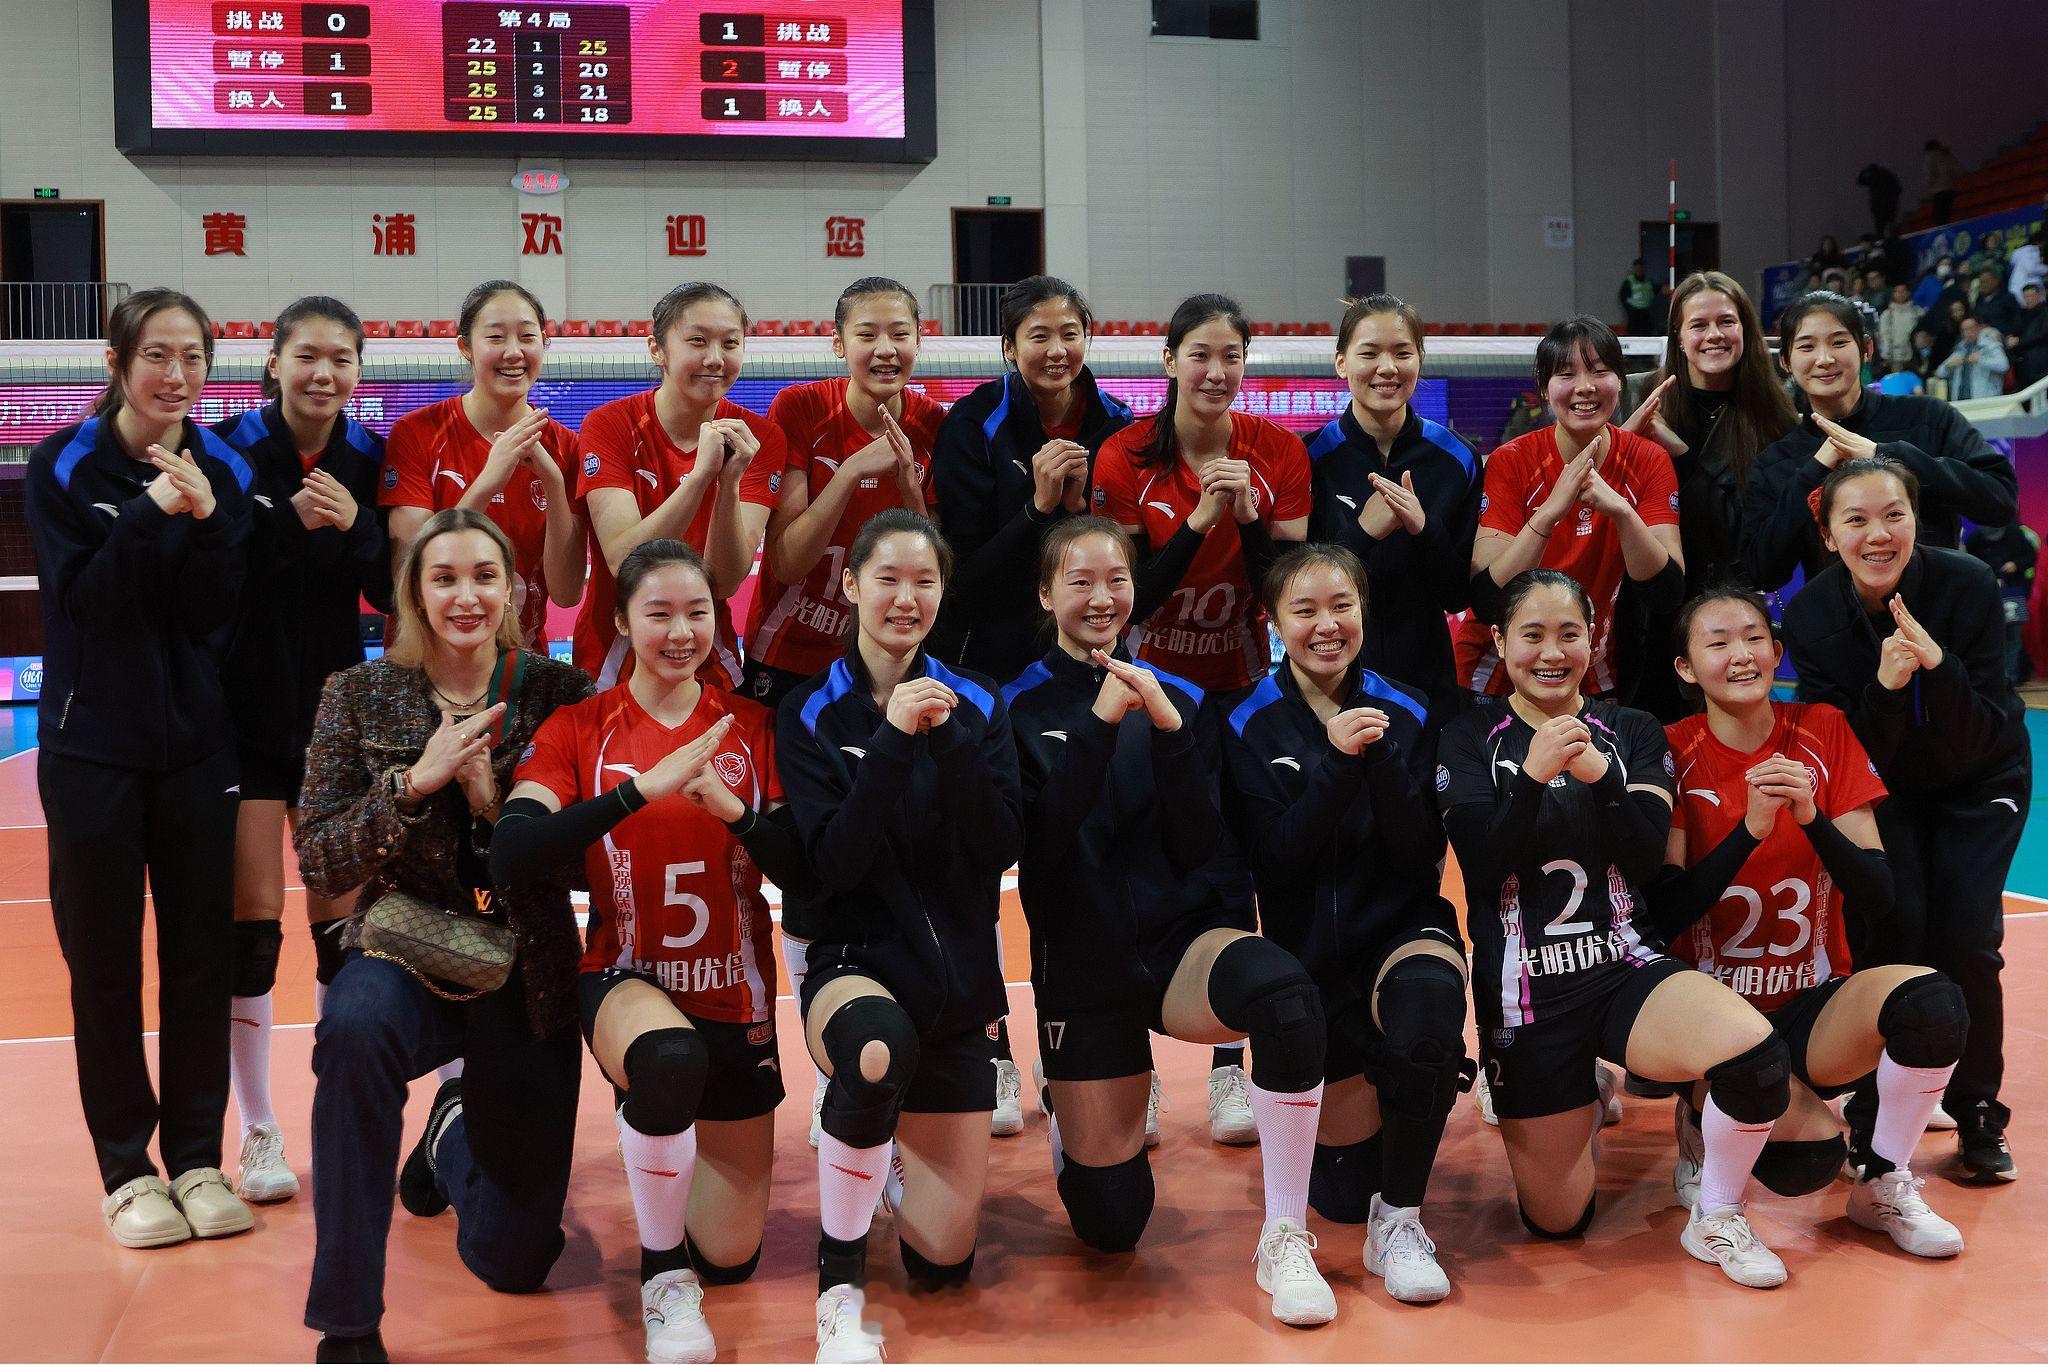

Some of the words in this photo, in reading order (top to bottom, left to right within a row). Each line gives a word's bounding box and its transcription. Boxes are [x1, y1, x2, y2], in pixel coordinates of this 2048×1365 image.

[226, 10, 284, 31] 挑战
[327, 13, 346, 31] 0
[722, 22, 739, 40] 1
[776, 23, 832, 42] 挑战
[467, 37, 497, 54] 22
[532, 41, 543, 53] 1
[578, 40, 608, 56] 25
[227, 50, 285, 69] 暂停
[329, 52, 346, 71] 1
[467, 61, 497, 76] 25
[532, 63, 544, 76] 2
[578, 63, 609, 78] 20
[721, 60, 739, 77] 2
[777, 61, 832, 79] 暂停
[228, 90, 286, 110] 换人
[330, 92, 347, 110] 1
[467, 83, 498, 99] 25
[532, 84, 545, 98] 3
[579, 84, 608, 101] 21
[468, 106, 498, 121] 25
[532, 107, 546, 120] 4
[580, 107, 609, 122] 18
[723, 98, 740, 116] 1
[778, 98, 832, 117] 换人
[1172, 583, 1237, 629] 10
[612, 849, 635, 947] 更强保护力
[662, 861, 709, 948] 5
[1541, 859, 1593, 936] 2
[1720, 878, 1811, 958] 23
[1045, 1021, 1066, 1050] 17
[1490, 1058, 1504, 1086] 2
